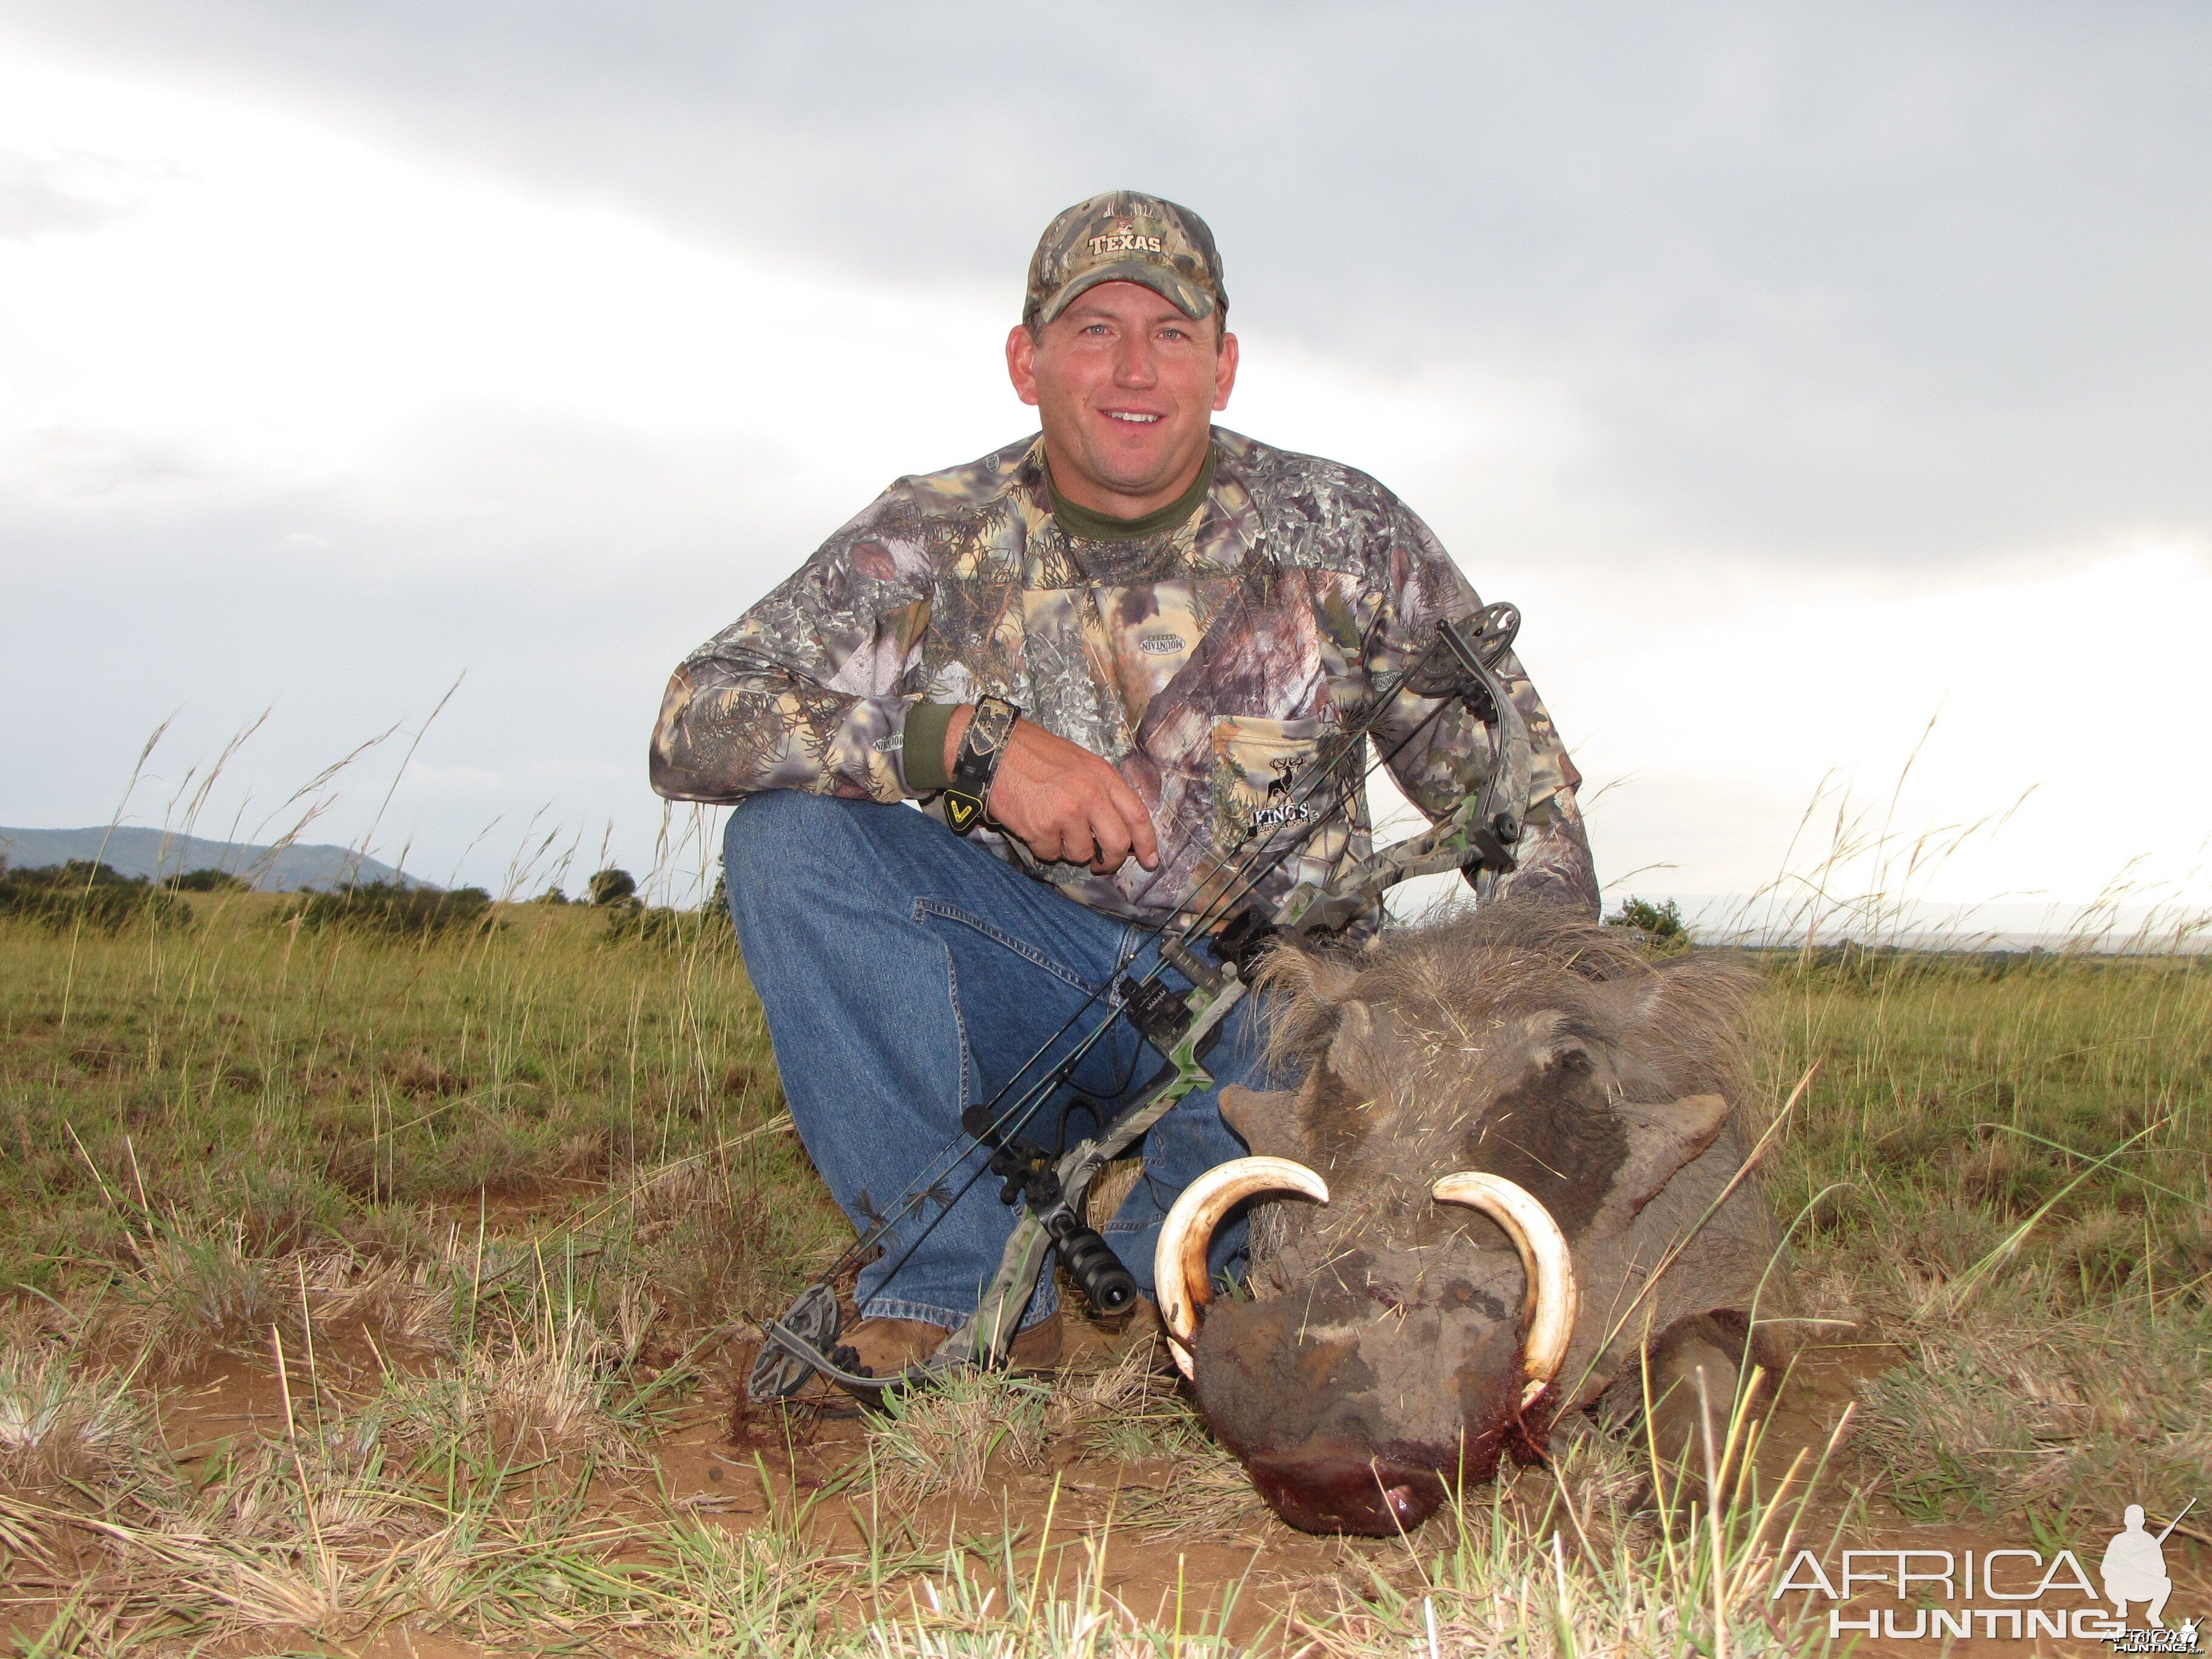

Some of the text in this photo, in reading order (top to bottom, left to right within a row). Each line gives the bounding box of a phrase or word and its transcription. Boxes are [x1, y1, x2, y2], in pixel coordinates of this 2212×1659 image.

[1088, 234, 1161, 255] TEXAS
[1142, 640, 1182, 652] MOUNTAIN
[1255, 802, 1308, 825] KINGS
[1286, 817, 1308, 828] WORLD
